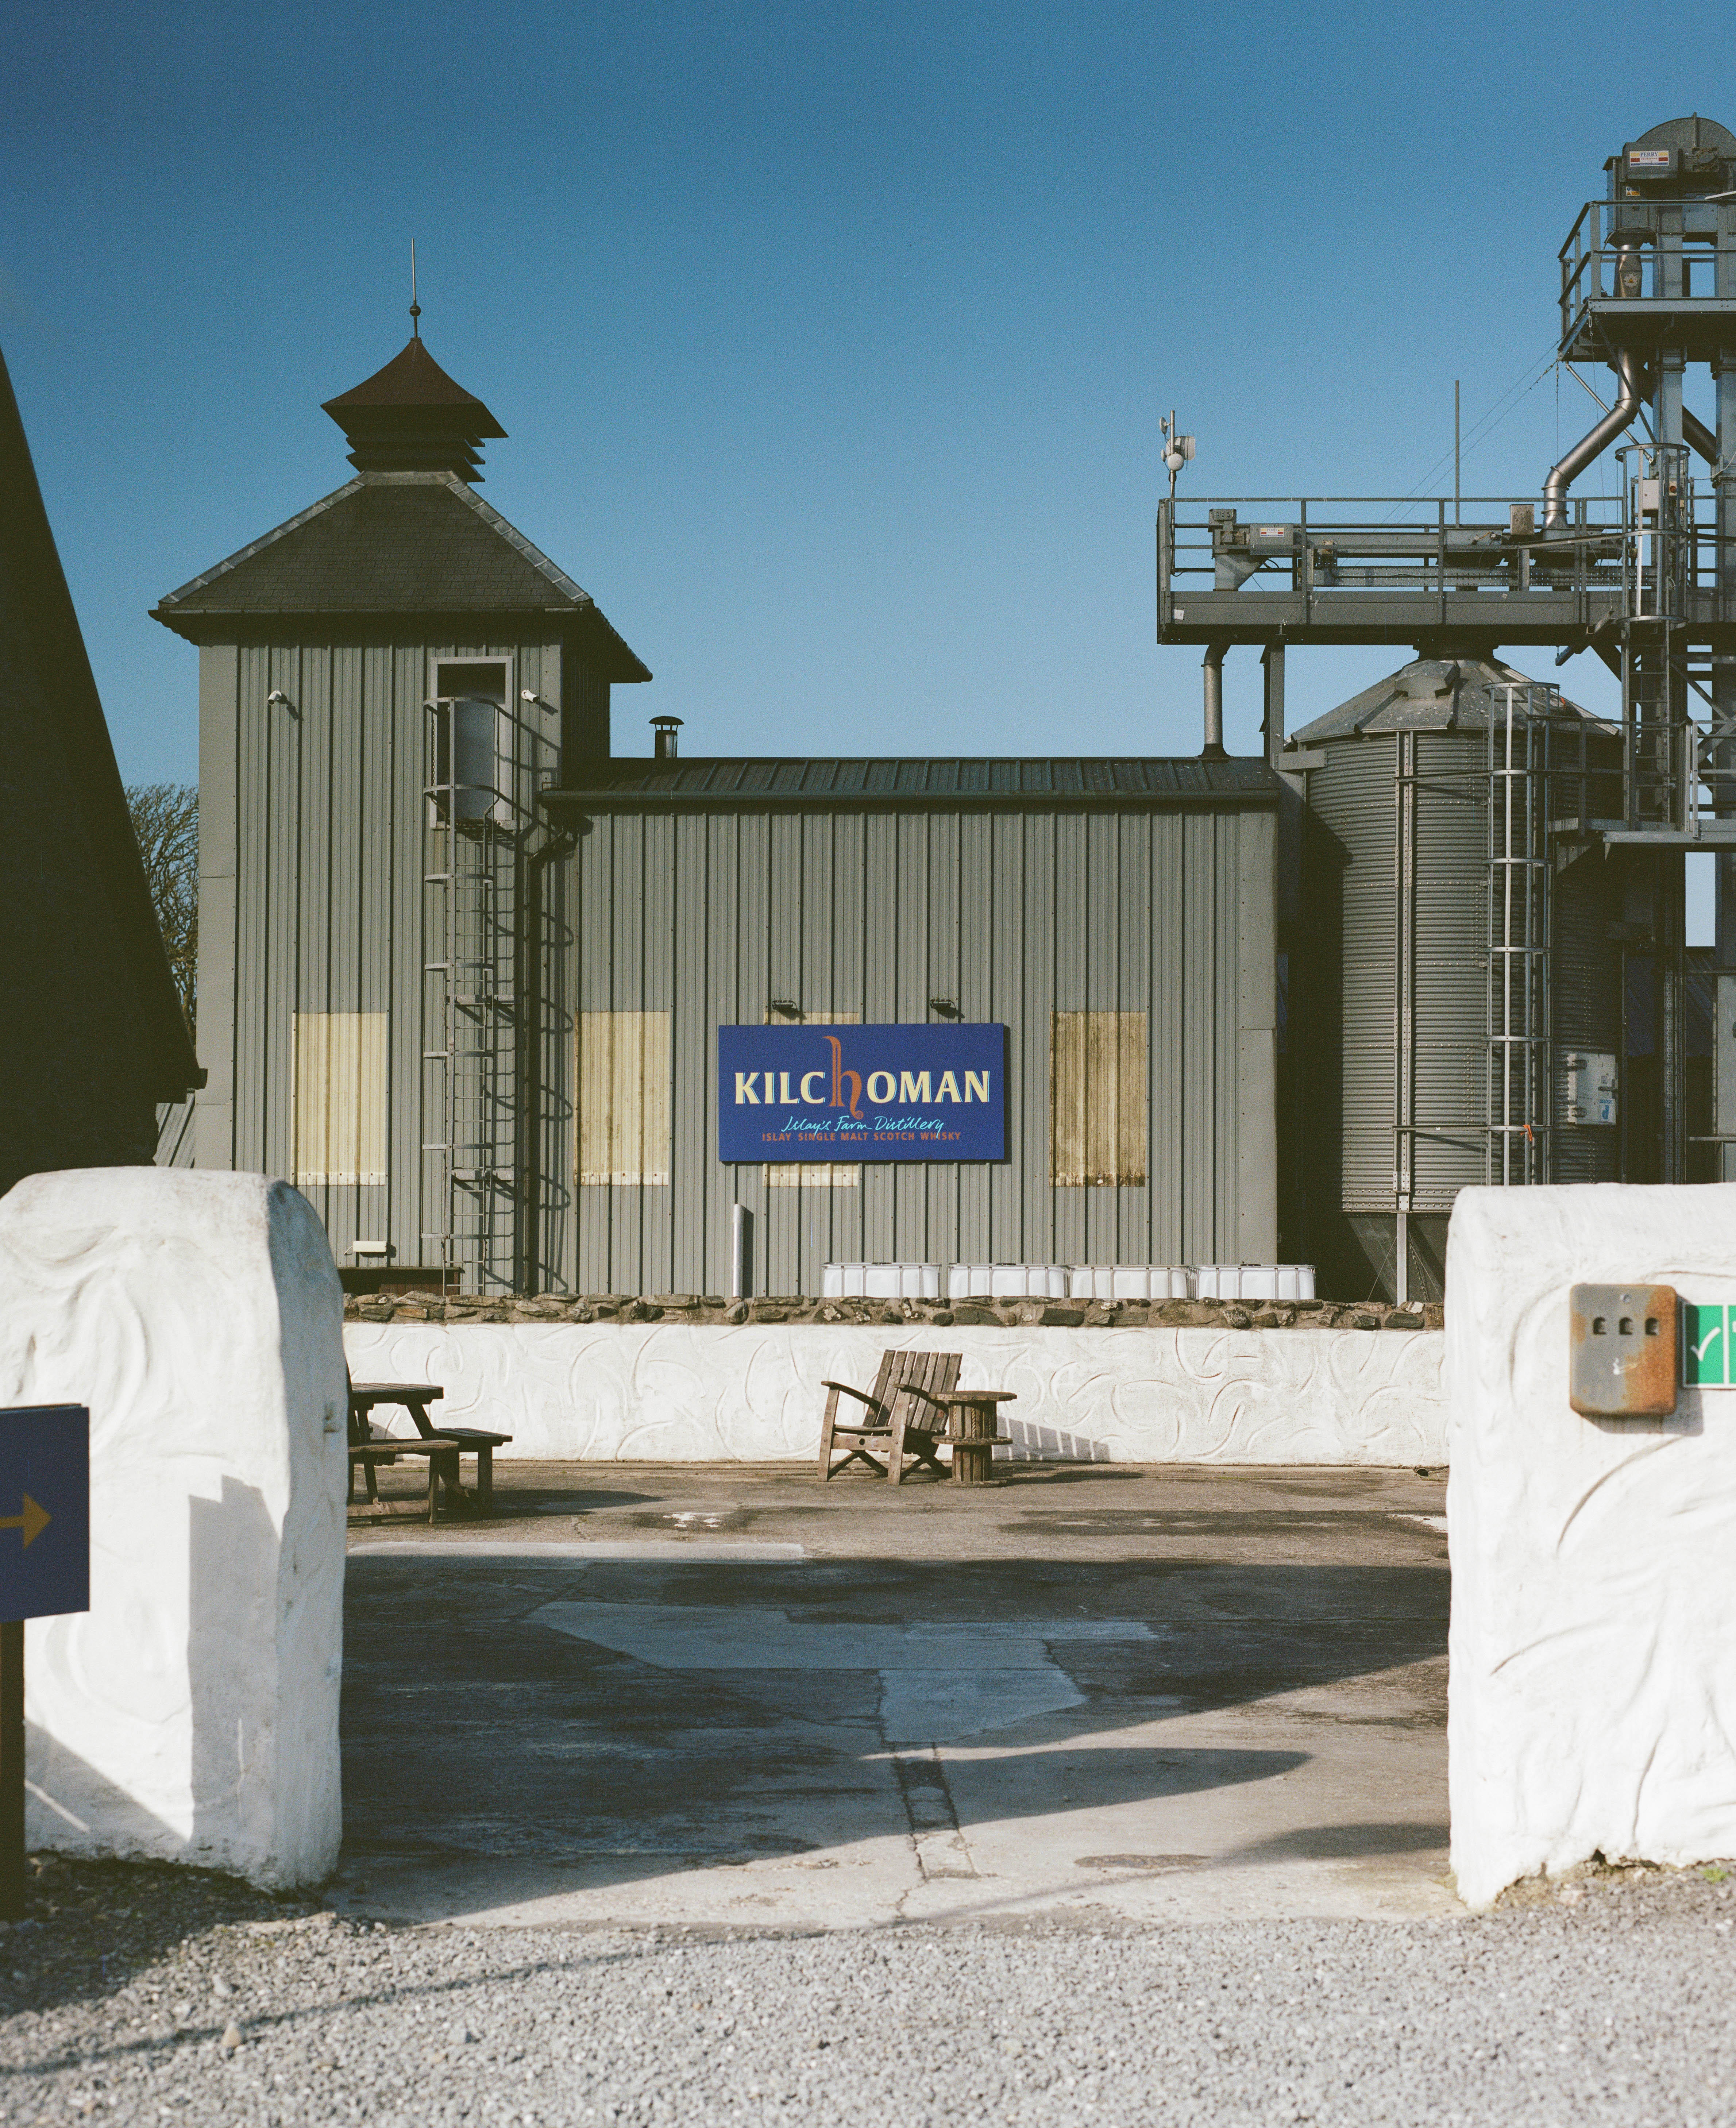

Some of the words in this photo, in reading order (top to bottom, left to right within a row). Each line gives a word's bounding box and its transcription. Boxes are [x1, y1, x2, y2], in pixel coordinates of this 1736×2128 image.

[781, 1116, 831, 1137] Islay's
[834, 1115, 872, 1132] Farm
[875, 1116, 944, 1138] Distillery
[762, 1133, 791, 1141] ISLAY
[798, 1133, 836, 1141] SINGLE
[840, 1133, 868, 1141] MALT
[873, 1132, 915, 1141] SCOTCH
[920, 1132, 961, 1141] WHISKY
